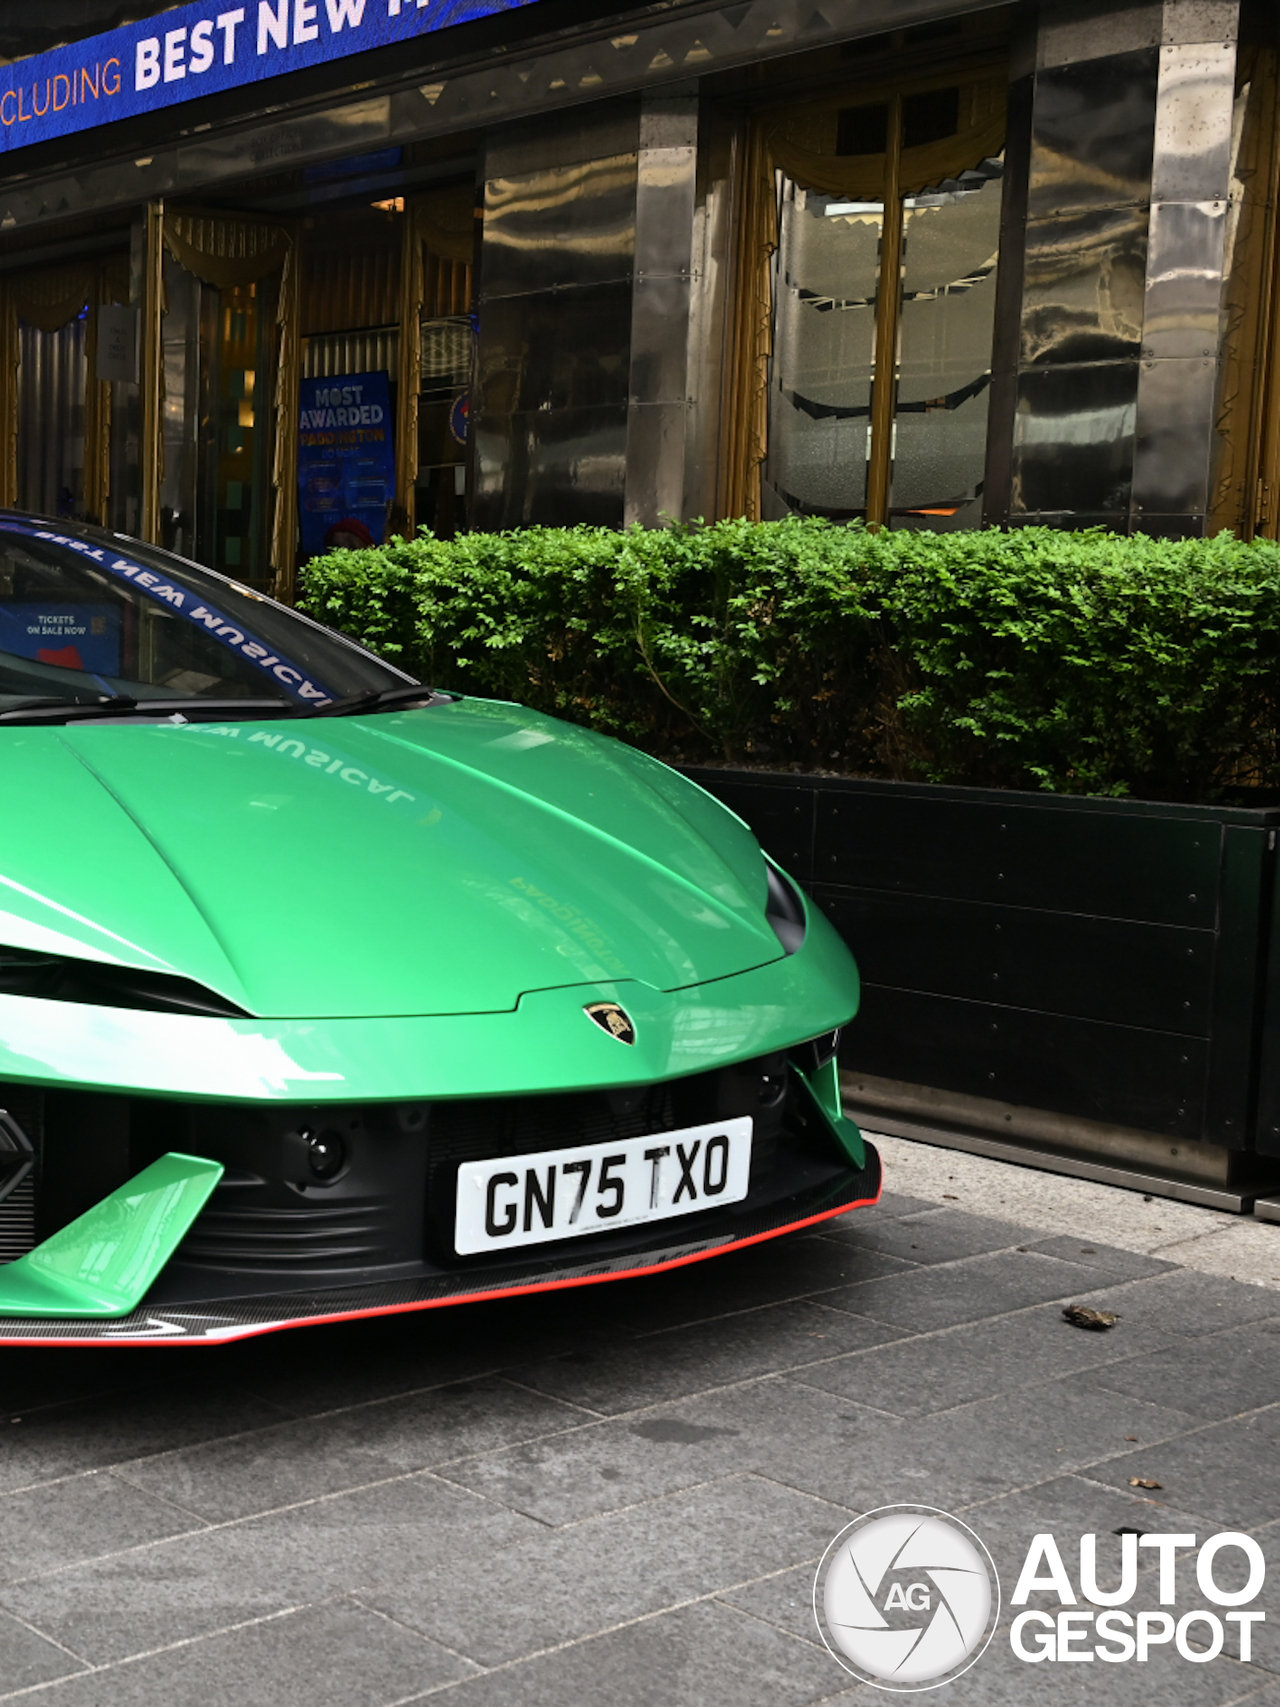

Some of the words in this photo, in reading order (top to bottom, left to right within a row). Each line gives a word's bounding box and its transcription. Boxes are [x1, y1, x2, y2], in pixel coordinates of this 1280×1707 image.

[134, 8, 245, 92] BEST
[256, 0, 367, 55] NEW
[314, 384, 364, 408] MOST
[299, 403, 384, 430] AWARDED
[26, 625, 41, 635] ON
[41, 625, 64, 636] SALE
[64, 626, 87, 636] NOW
[37, 615, 76, 625] TICKETS
[484, 1153, 627, 1238] GN75
[643, 1135, 730, 1210] TXO
